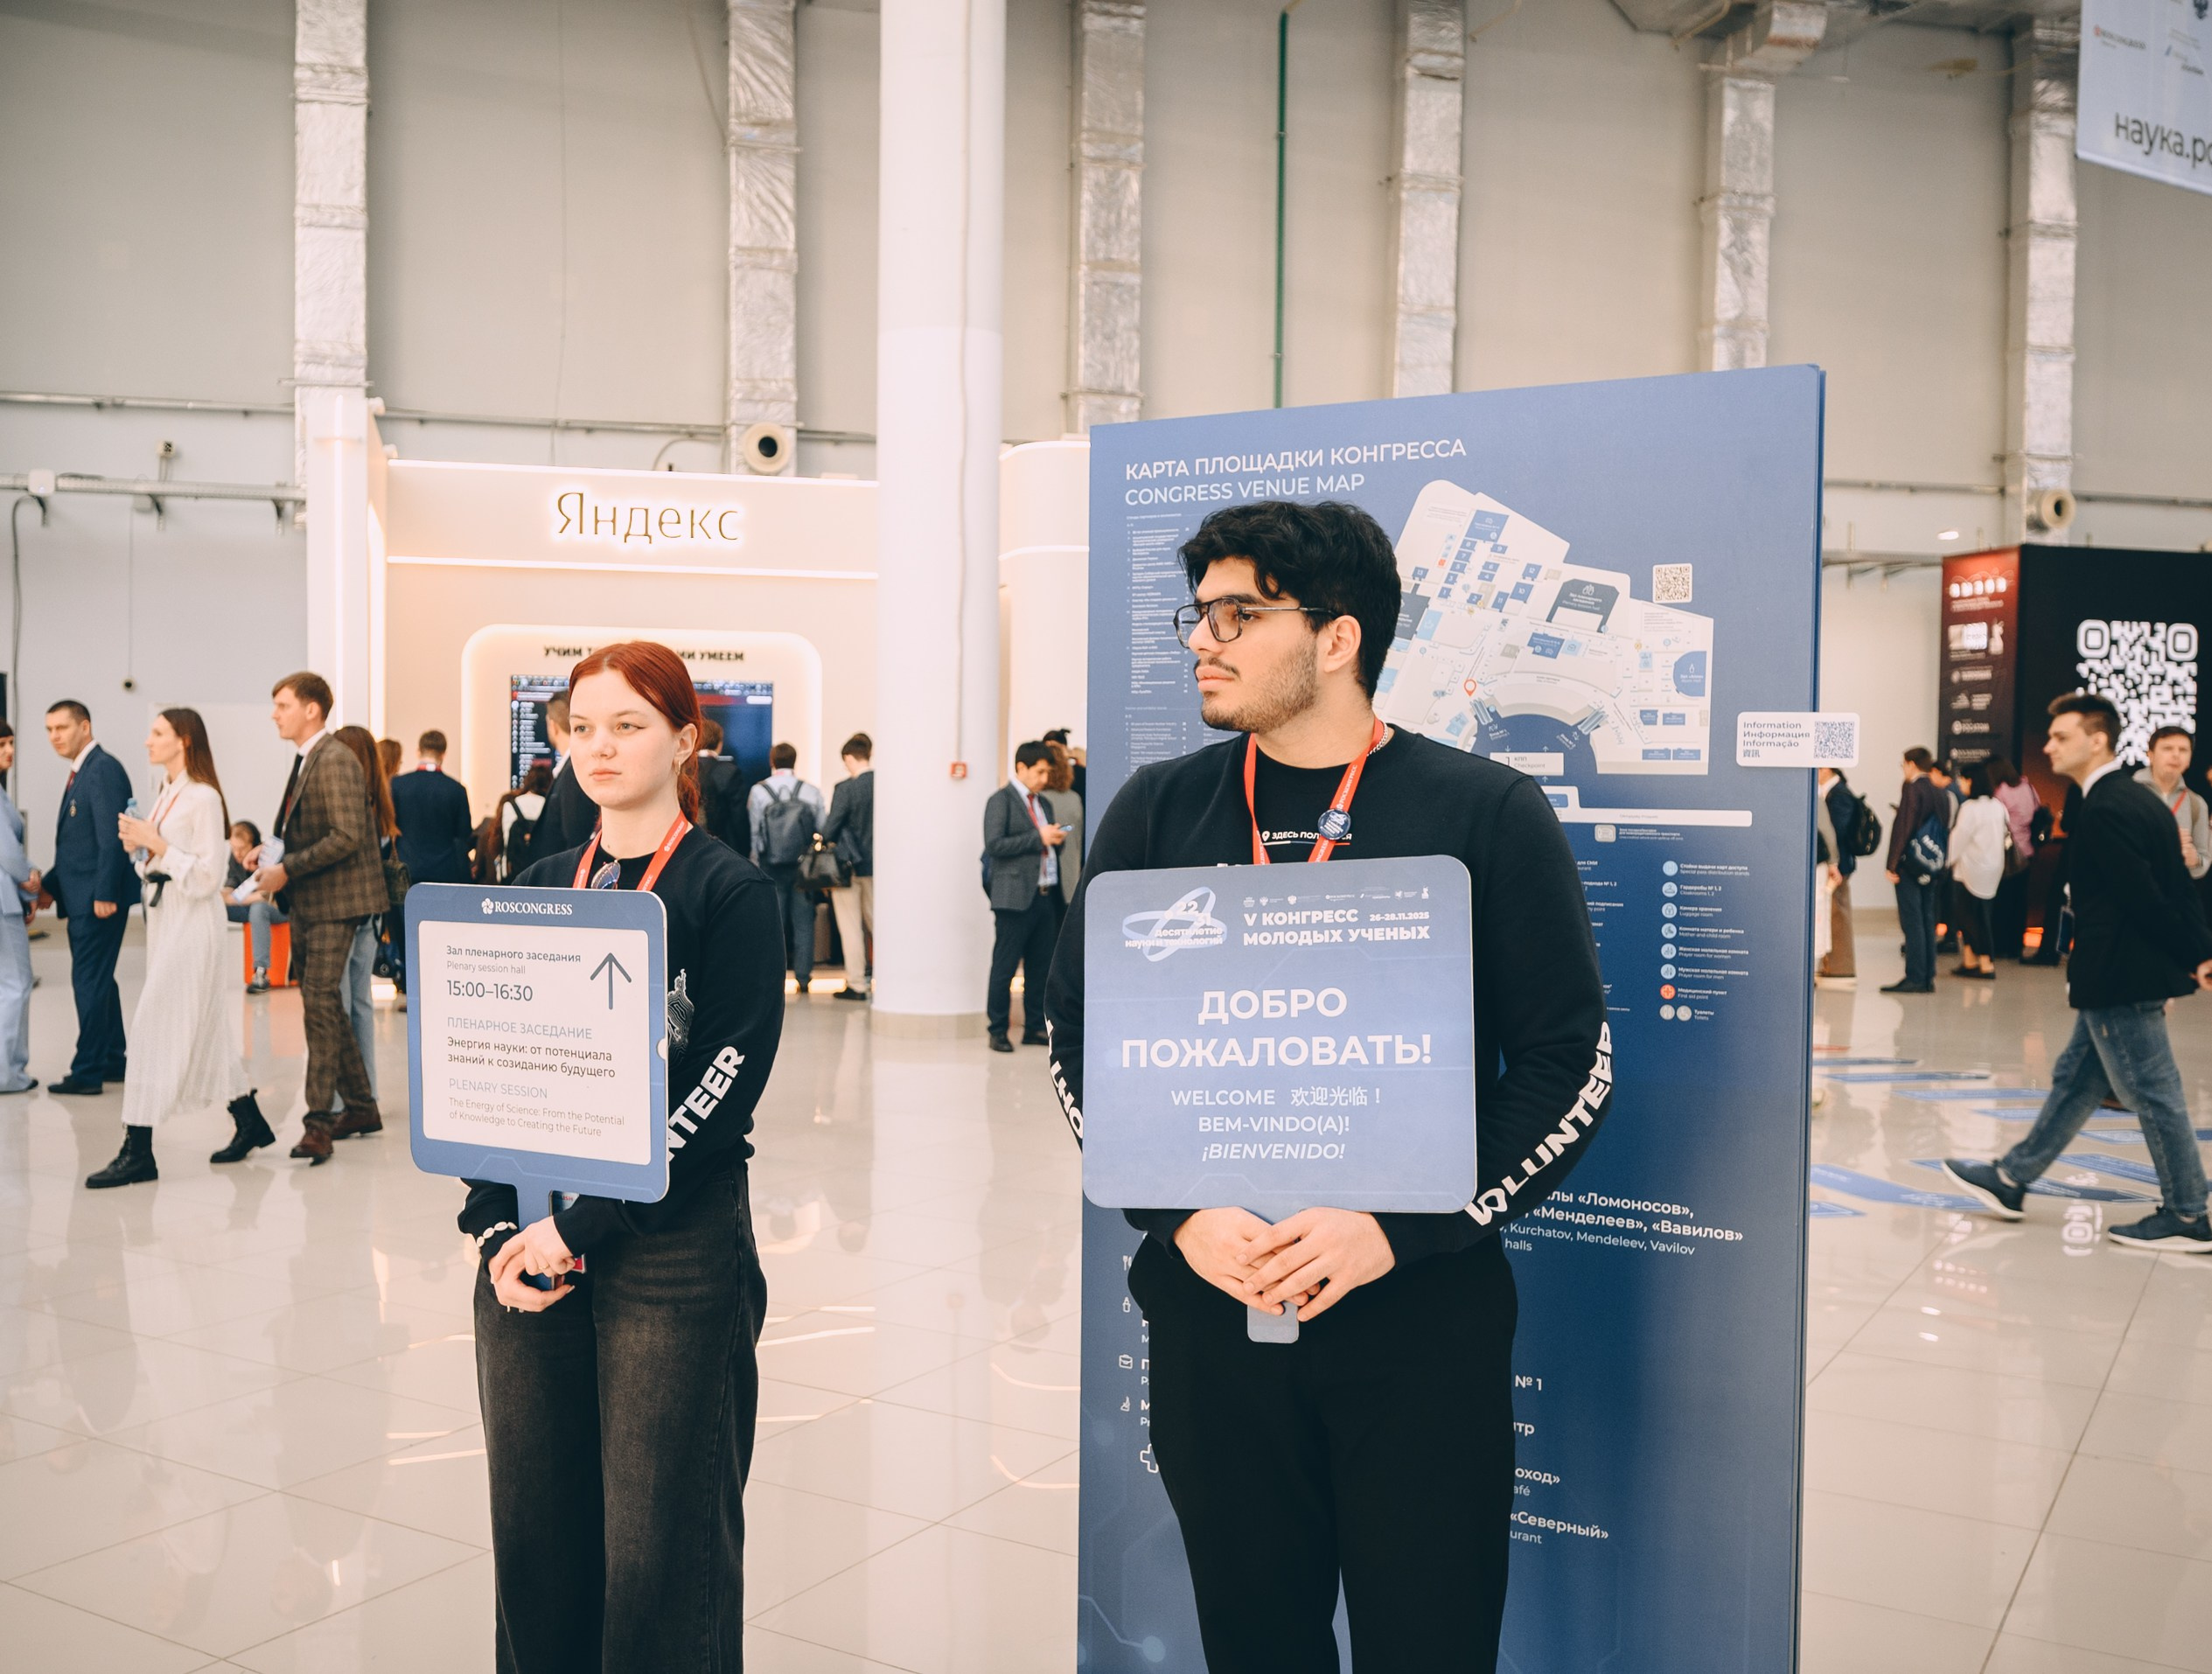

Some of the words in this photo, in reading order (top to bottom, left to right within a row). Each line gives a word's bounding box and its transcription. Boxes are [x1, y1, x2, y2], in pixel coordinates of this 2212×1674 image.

[1126, 461, 1189, 480] КАРТА
[1195, 449, 1323, 475] ПЛОЩАДКИ
[1330, 438, 1466, 464] КОНГРЕССА
[1125, 483, 1232, 506] CONGRESS
[1238, 477, 1309, 499] VENUE
[1316, 473, 1364, 492] MAP
[557, 492, 738, 544] Яндекс
[1272, 831, 1298, 840] ЗДЕСЬ
[494, 900, 573, 916] ROSCONGRESS
[1176, 900, 1198, 916] 22
[1244, 913, 1258, 926] V
[1262, 909, 1358, 925] КОНГРЕСС
[1165, 938, 1223, 946] технологий
[1244, 929, 1343, 946] МОЛОДЫХ
[1348, 926, 1430, 943] УЧЕНЫХ
[447, 945, 463, 957] Зал
[465, 947, 524, 960] пленарного
[526, 951, 581, 963] заседания
[447, 960, 476, 973] Plenary
[478, 962, 512, 973] session
[513, 964, 526, 974] hall
[1197, 987, 1348, 1026] ДОБРО
[448, 1017, 517, 1034] ПЛЕНАРНОЕ
[520, 1022, 592, 1040] ЗАСЕДАНИЕ
[447, 1037, 491, 1052] Энергия
[494, 1041, 527, 1056] науки:
[530, 1045, 542, 1056] от
[545, 1047, 612, 1062] потенциала
[1121, 1034, 1432, 1069] ПОЖАЛОВАТЬ!
[448, 1053, 485, 1065] знаний
[487, 1057, 494, 1066] к
[497, 1058, 558, 1073] созиданию
[561, 1063, 616, 1078] будущего
[450, 1078, 498, 1094] PLENARY
[500, 1083, 548, 1099] SESSION
[1171, 1089, 1275, 1106] WELCOME
[449, 1097, 464, 1109] The
[465, 1099, 494, 1113] Energy
[496, 1102, 505, 1113] of
[506, 1104, 541, 1117] Science:
[542, 1107, 565, 1119] From
[568, 1110, 583, 1121] the
[584, 1111, 625, 1126] Potential
[450, 1111, 457, 1120] of
[459, 1112, 506, 1126] Knowledge
[507, 1116, 515, 1126] to
[518, 1118, 554, 1133] Creating
[556, 1121, 571, 1132] the
[573, 1122, 602, 1137] Future
[1198, 1115, 1350, 1135] BEM-VINDO(A)!
[1202, 1142, 1345, 1162] ¡BIENVENIDO!
[1578, 1191, 1694, 1218] «Ломоносов»,
[1533, 1206, 1648, 1232] «Менделеев»,
[1651, 1221, 1743, 1242] «Вавилов»
[1504, 1238, 1532, 1252] halls
[1510, 1223, 1574, 1242] Kurchatov,
[1576, 1231, 1648, 1252] Mendeleev,
[1650, 1240, 1695, 1256] Vavilov
[1515, 1375, 1532, 1388] №
[1537, 1378, 1542, 1391] 1
[1513, 1485, 1531, 1496] afé
[1511, 1511, 1608, 1539] «Северный»
